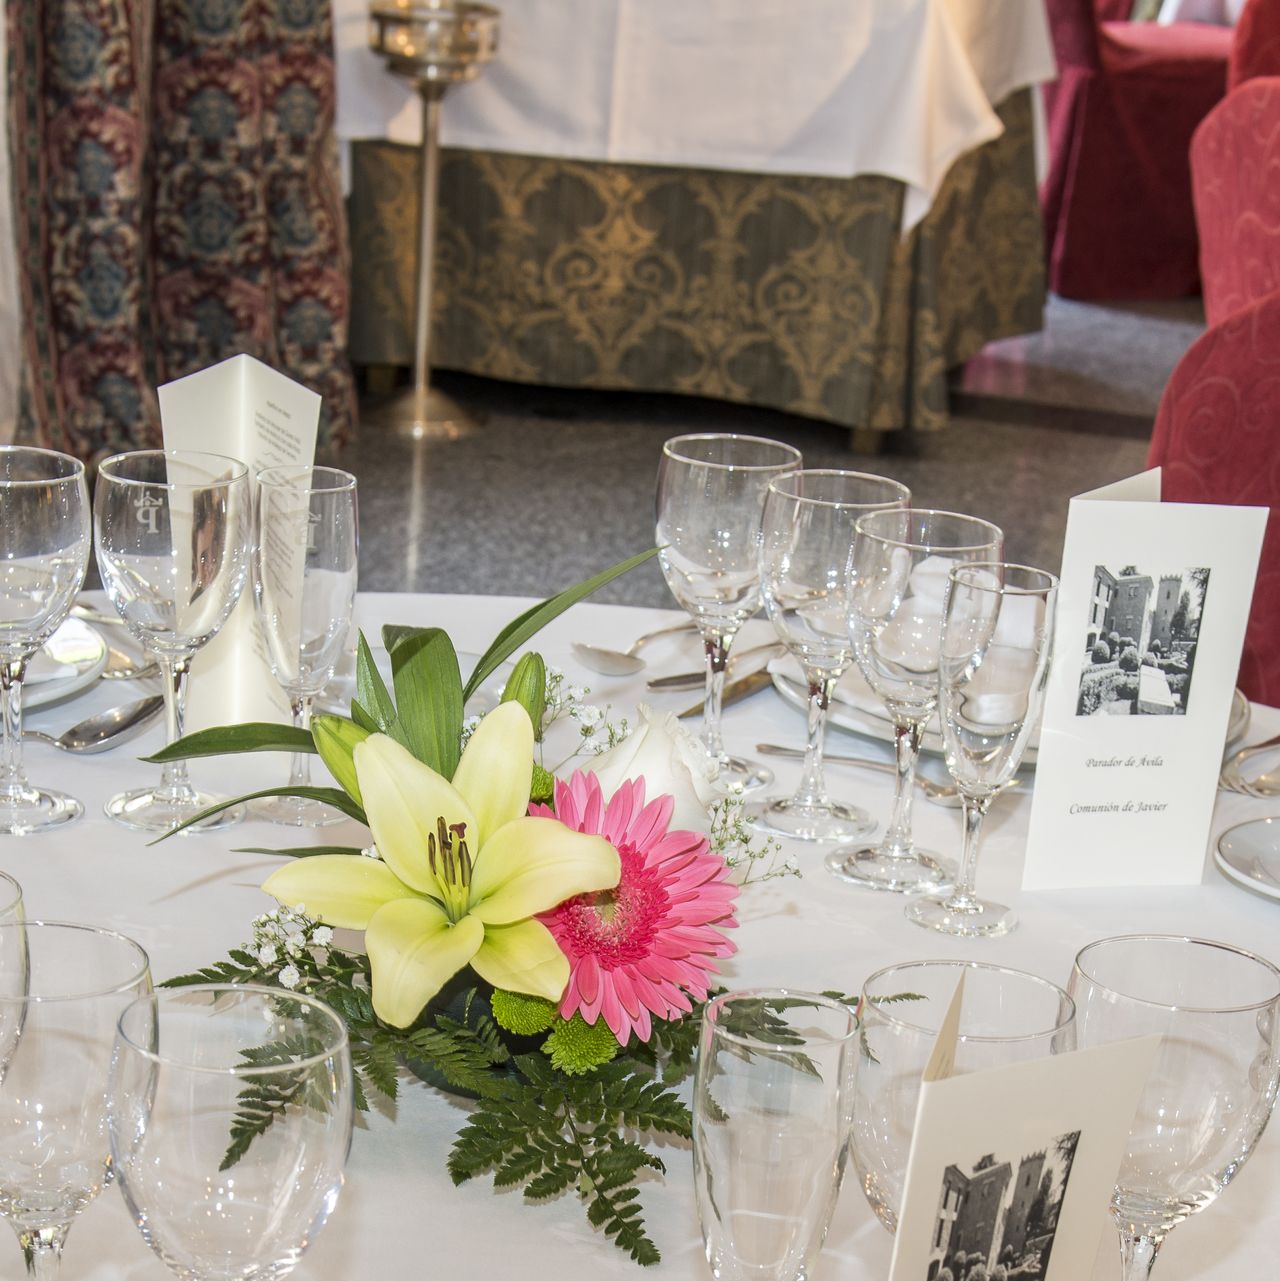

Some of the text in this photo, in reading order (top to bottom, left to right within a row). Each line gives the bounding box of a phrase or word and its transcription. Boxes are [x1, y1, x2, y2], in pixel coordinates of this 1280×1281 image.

[1085, 755, 1163, 768] Parador de Ávila
[1069, 801, 1168, 814] Comunión de Javier
